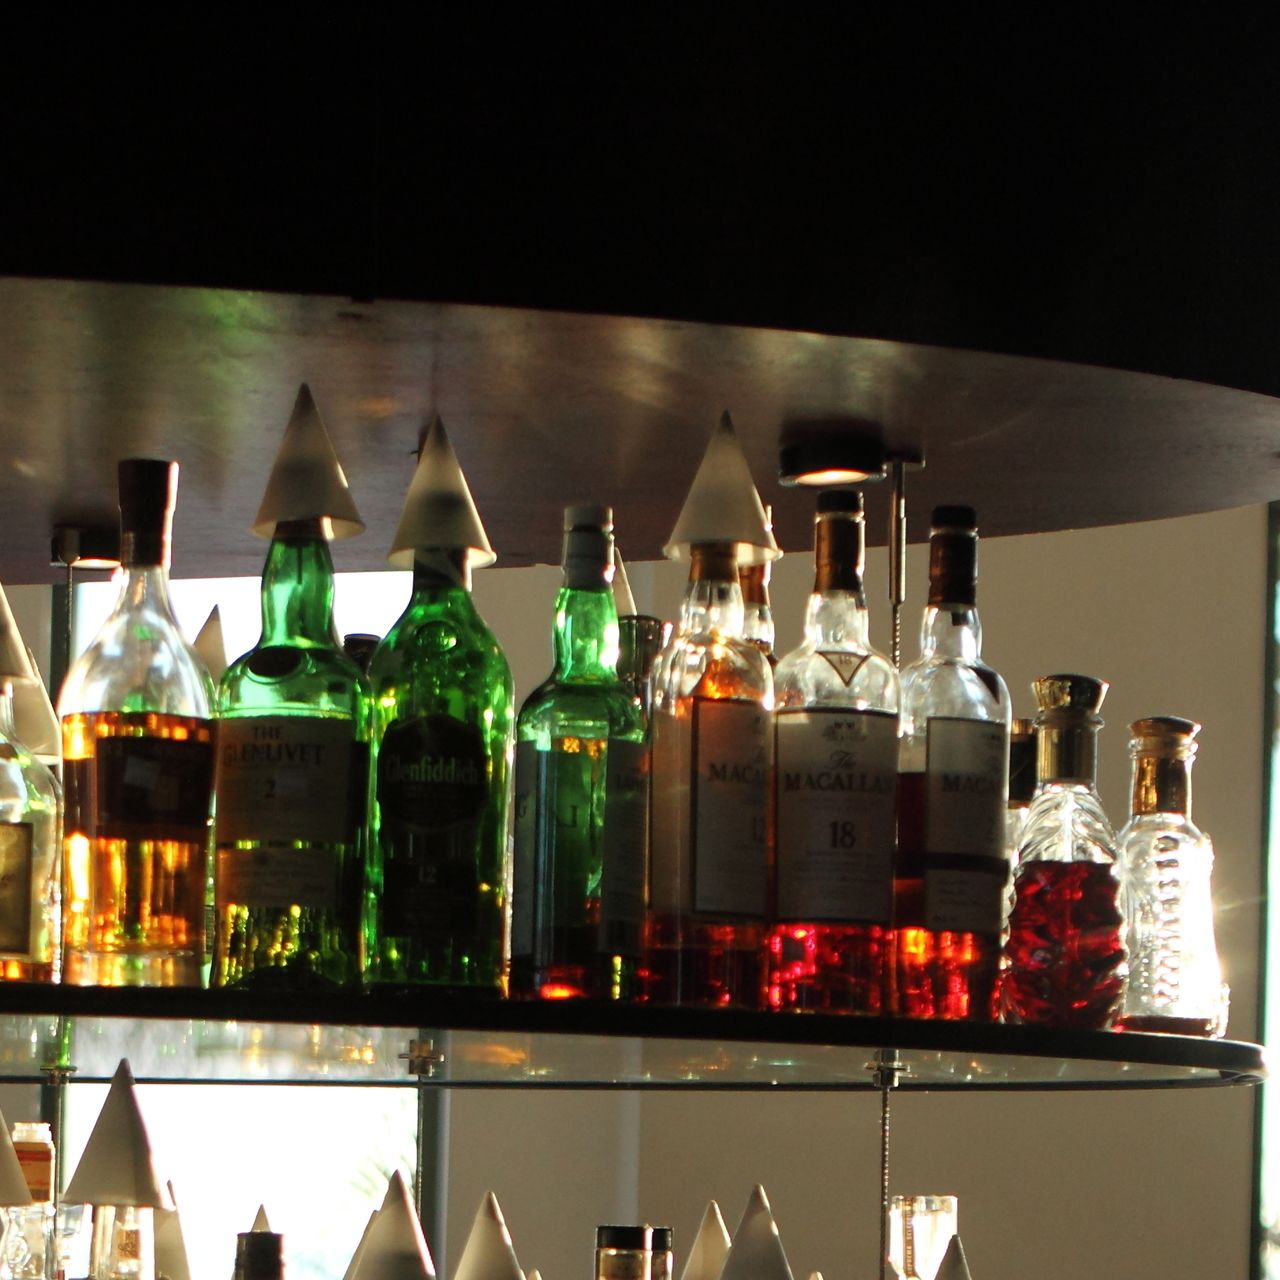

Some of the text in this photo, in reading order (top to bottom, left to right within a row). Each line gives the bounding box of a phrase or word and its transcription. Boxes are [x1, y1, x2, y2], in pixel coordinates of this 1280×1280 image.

[253, 725, 283, 741] THE
[223, 743, 325, 768] GLENLIVET
[385, 756, 479, 786] Glenfiddich
[784, 772, 893, 793] MACALLAN
[829, 820, 857, 849] 18
[418, 865, 438, 884] 12
